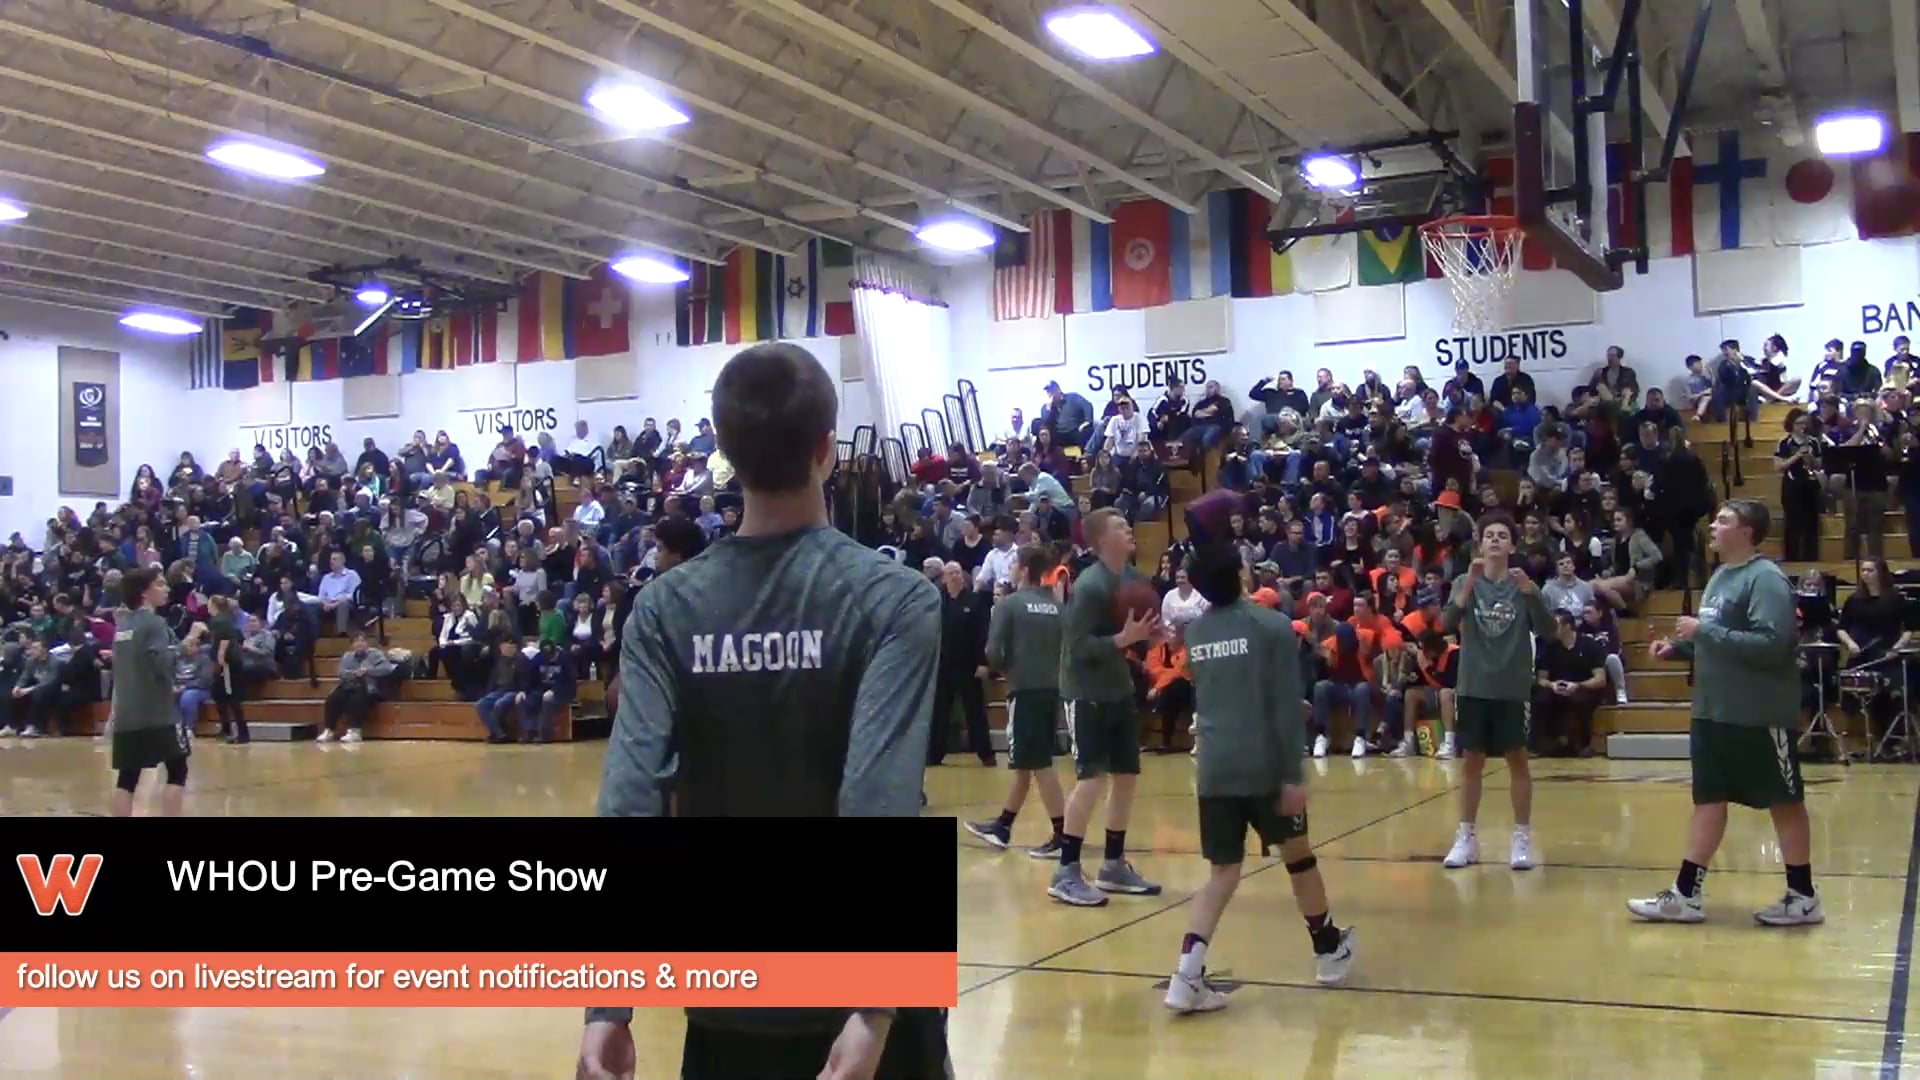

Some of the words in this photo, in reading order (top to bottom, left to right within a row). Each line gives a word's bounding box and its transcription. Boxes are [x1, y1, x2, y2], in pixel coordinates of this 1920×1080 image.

[1435, 330, 1567, 366] STUDENTS
[1088, 358, 1207, 391] STUDENTS
[474, 408, 558, 434] VISITORS
[254, 425, 332, 449] VISITORS
[692, 630, 823, 673] MAGOON
[1190, 638, 1249, 662] SEYMOUR
